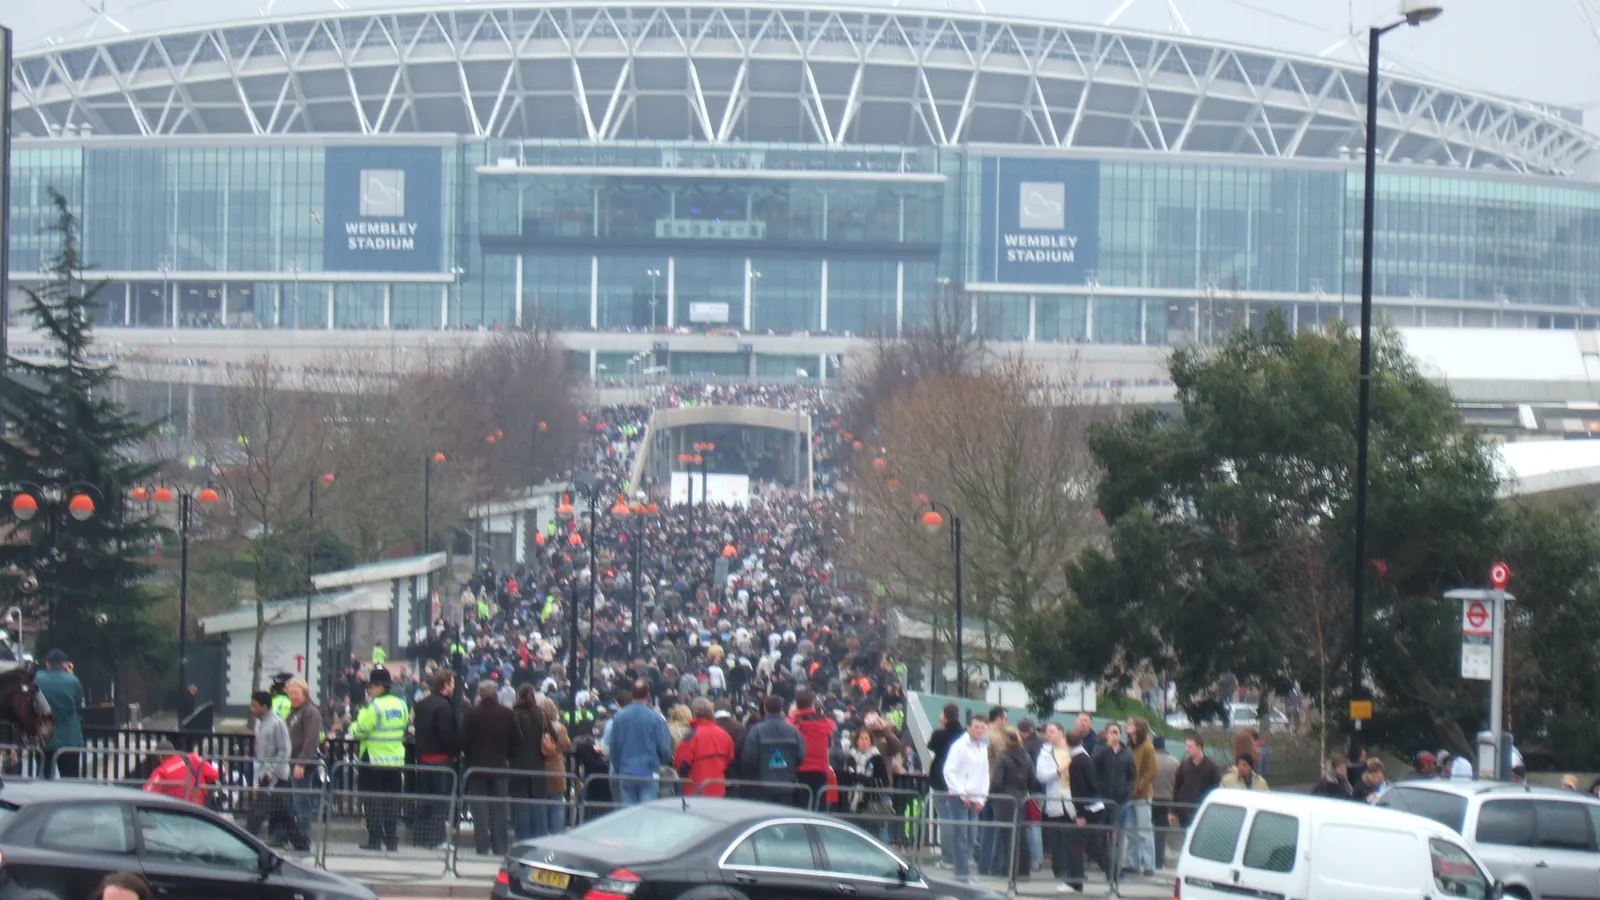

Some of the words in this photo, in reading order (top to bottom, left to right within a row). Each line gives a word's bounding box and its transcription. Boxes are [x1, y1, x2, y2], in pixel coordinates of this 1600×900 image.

[345, 222, 418, 235] WEMBLEY
[348, 237, 415, 250] STADIUM
[1004, 234, 1078, 247] WEMBLEY
[1007, 249, 1075, 262] STADIUM
